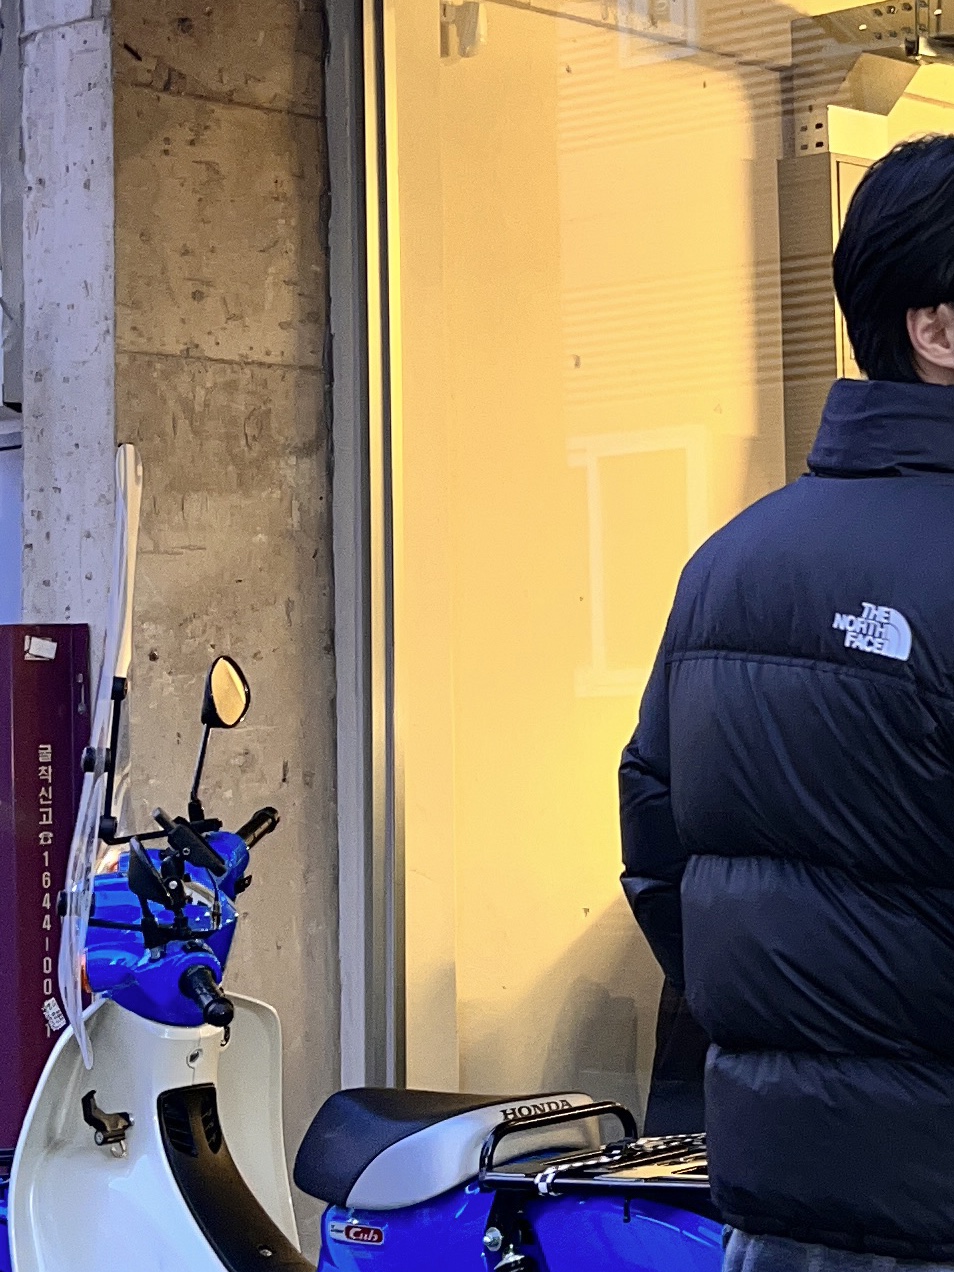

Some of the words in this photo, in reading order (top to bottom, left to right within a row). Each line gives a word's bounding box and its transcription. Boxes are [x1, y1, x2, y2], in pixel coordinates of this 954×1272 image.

[862, 602, 892, 623] THE
[832, 612, 886, 638] NORTH
[844, 631, 885, 654] FACE
[38, 744, 53, 825] 굴착신고
[42, 850, 53, 1038] 1644-001
[500, 1099, 573, 1121] HONDA
[349, 1227, 379, 1242] Cub
